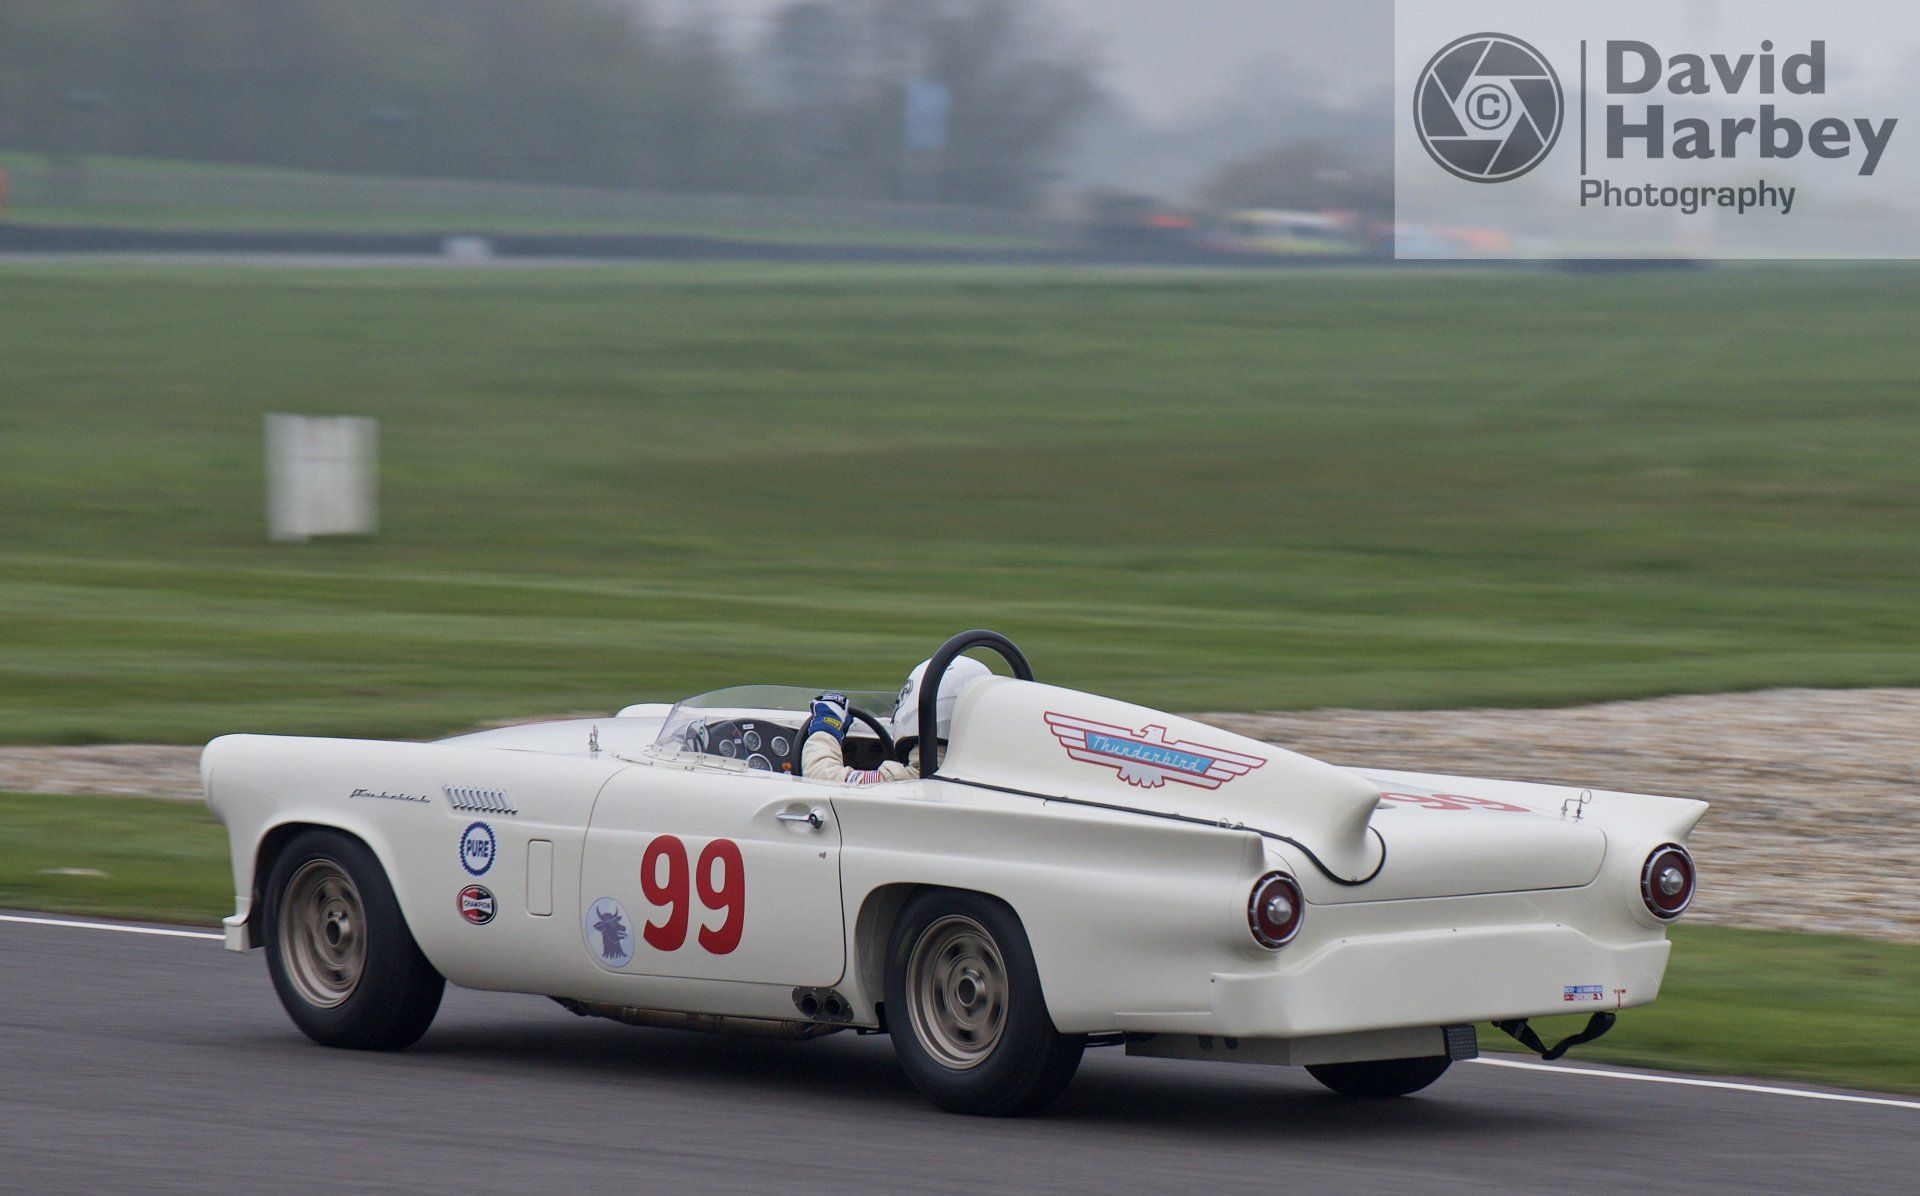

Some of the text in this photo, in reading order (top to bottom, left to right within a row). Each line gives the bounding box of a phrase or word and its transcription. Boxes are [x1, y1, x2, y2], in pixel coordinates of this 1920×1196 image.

[1092, 735, 1201, 773] Thunderbird
[1379, 792, 1532, 812] 99
[466, 838, 489, 858] PURE
[640, 834, 745, 955] 99
